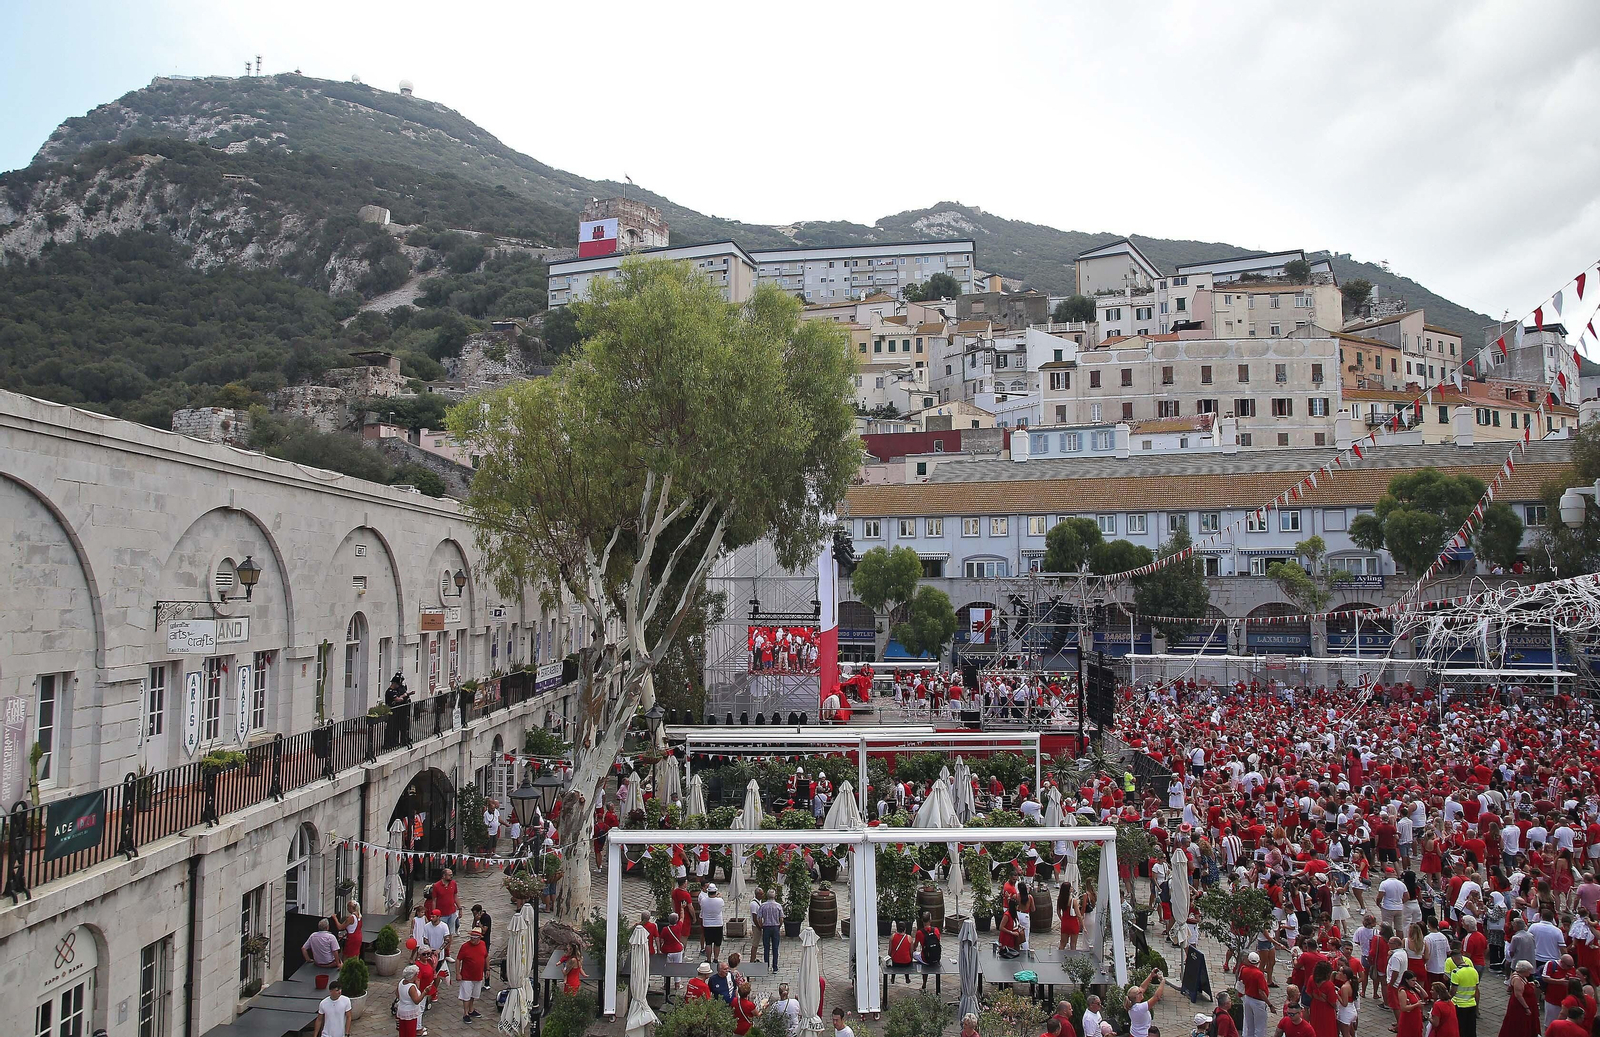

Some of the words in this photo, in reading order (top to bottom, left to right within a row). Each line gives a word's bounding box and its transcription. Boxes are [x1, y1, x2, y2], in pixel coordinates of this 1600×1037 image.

[169, 629, 187, 641] arts
[218, 622, 242, 640] AND
[187, 633, 215, 648] crafts
[1506, 636, 1559, 645] TRAMONI
[189, 674, 197, 727] ARTS
[239, 667, 247, 733] CRAFTS
[54, 821, 73, 837] ACE
